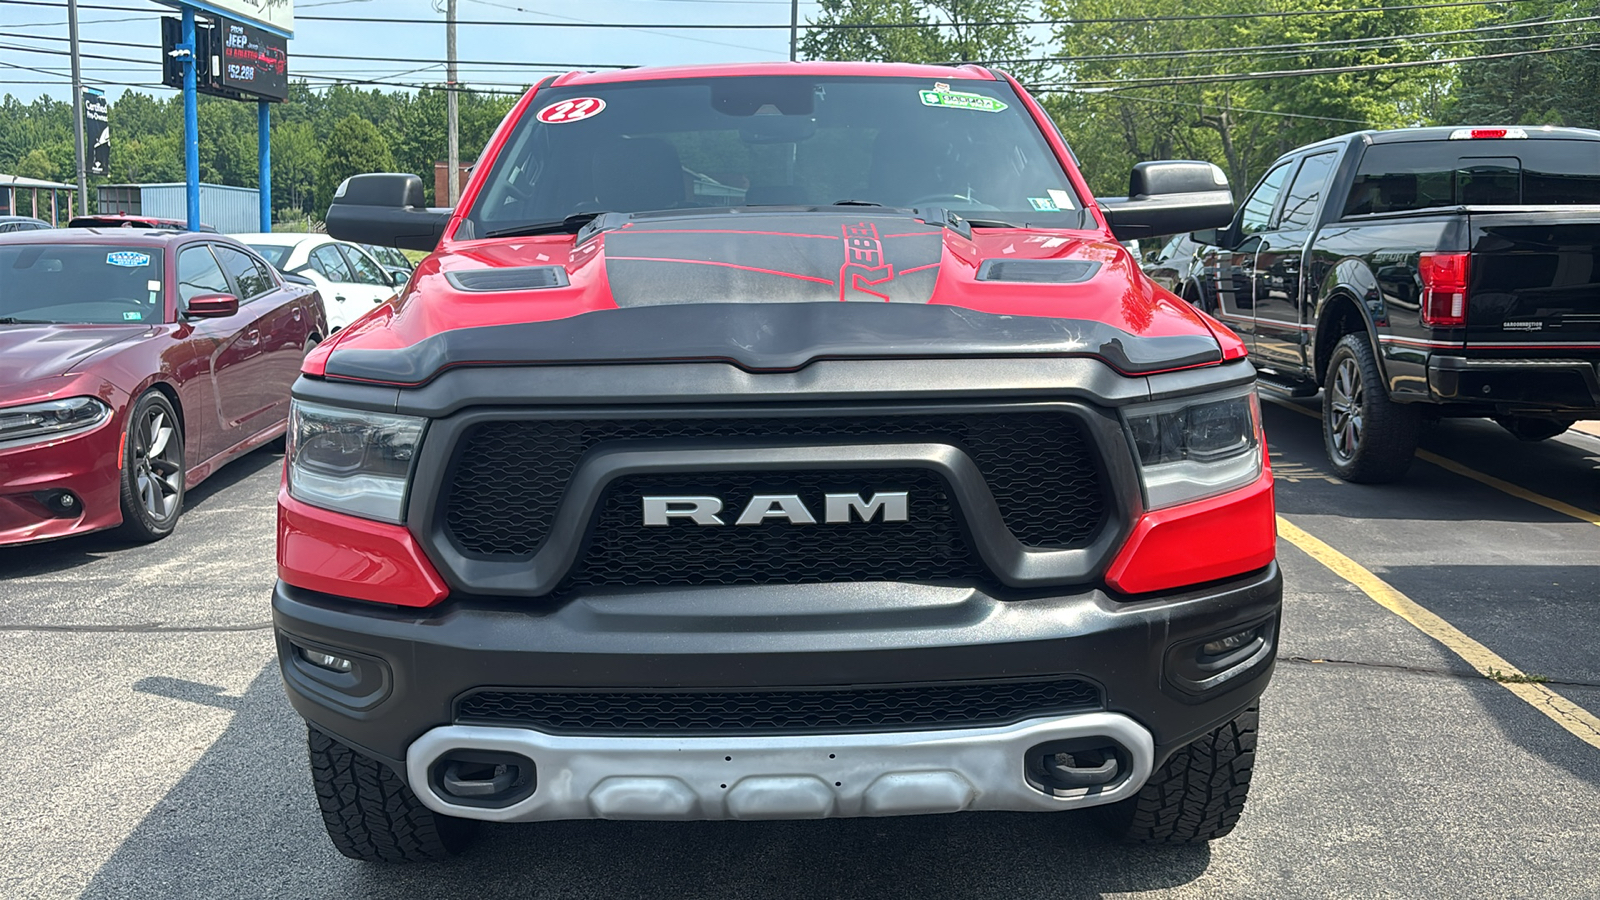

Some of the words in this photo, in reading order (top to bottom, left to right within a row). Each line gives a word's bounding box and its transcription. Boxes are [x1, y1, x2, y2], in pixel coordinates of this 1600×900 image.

[226, 33, 247, 49] JEEP
[85, 100, 107, 112] Certified
[547, 99, 595, 121] 22
[840, 222, 894, 302] REBEL
[642, 491, 909, 526] RAM
